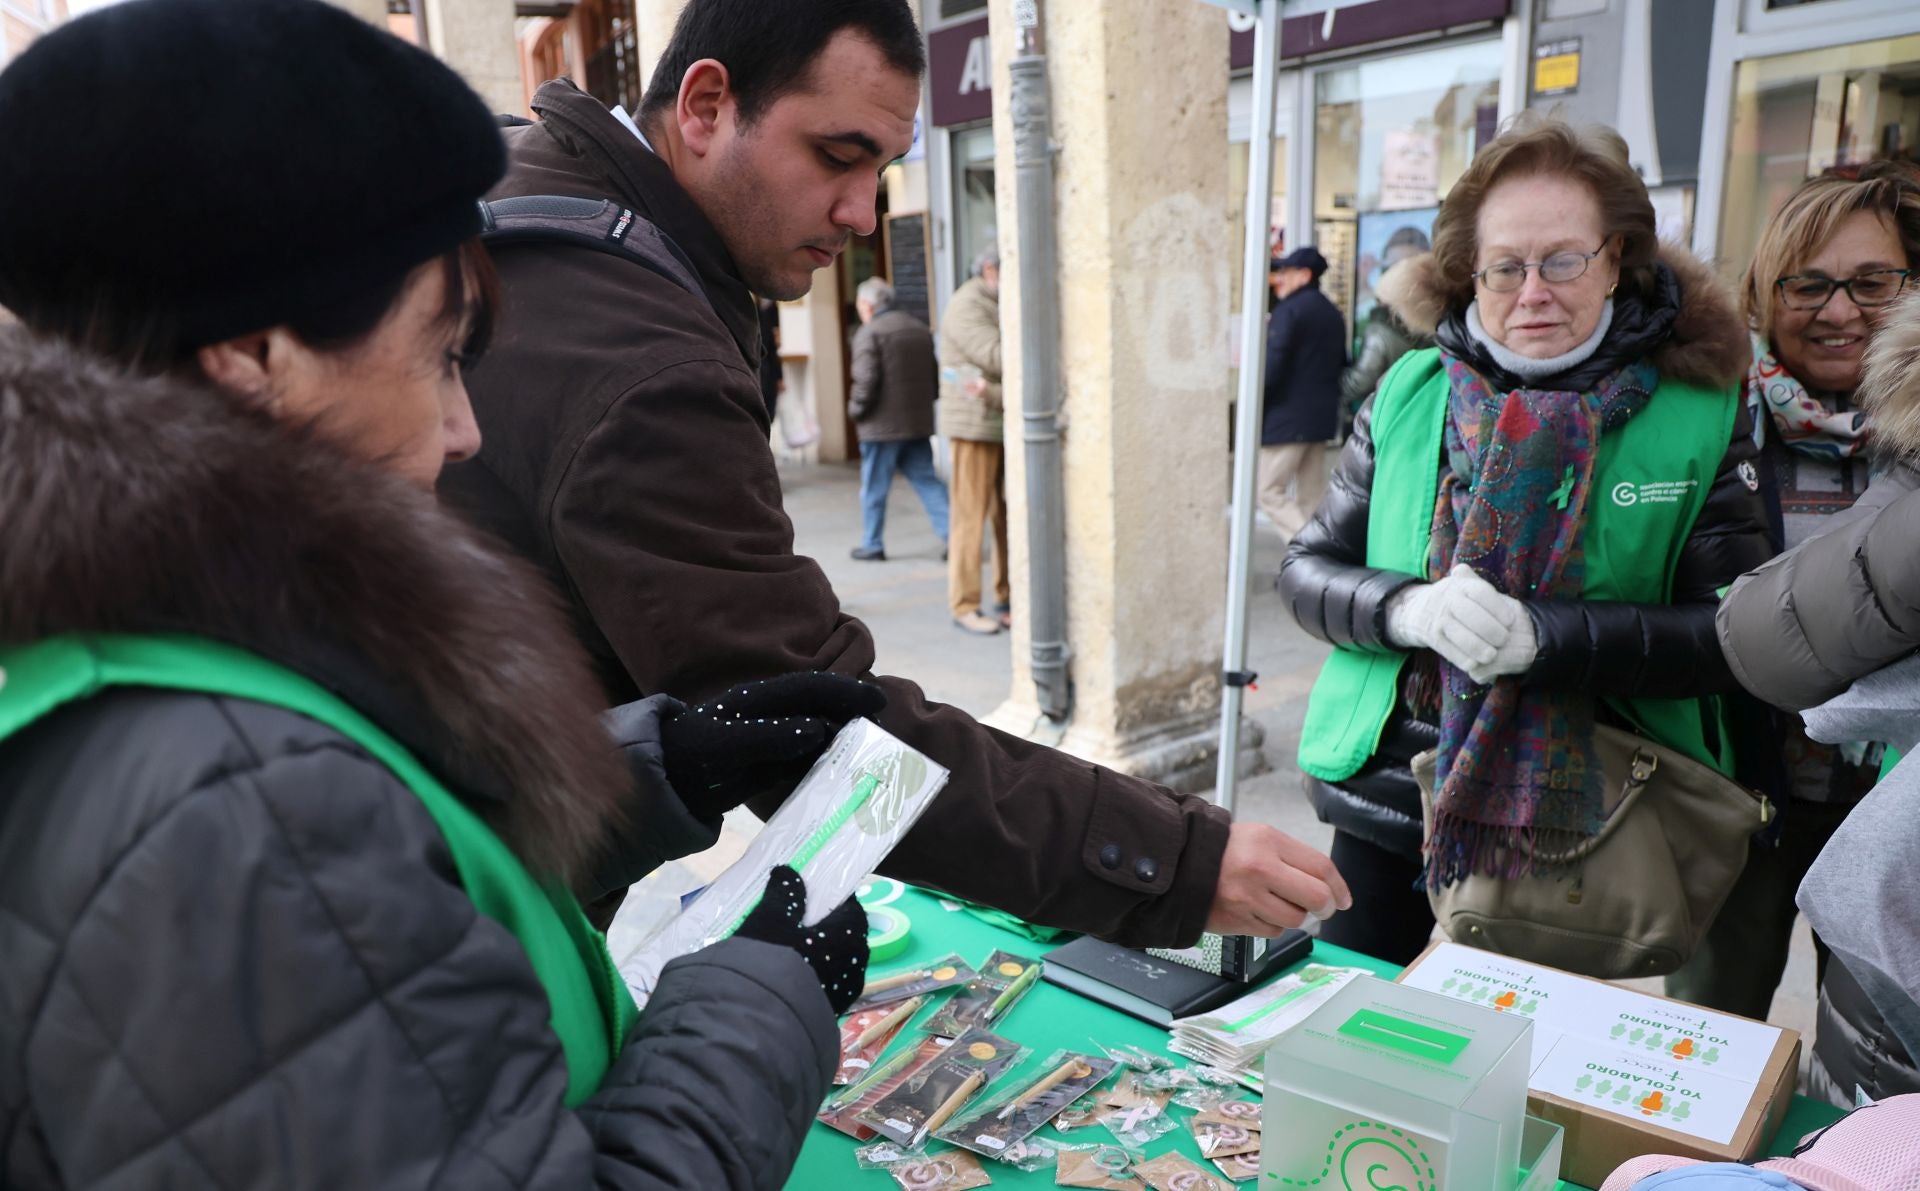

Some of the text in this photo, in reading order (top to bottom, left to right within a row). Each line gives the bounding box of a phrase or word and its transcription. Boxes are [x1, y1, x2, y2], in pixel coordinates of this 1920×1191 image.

[1651, 495, 1678, 503] Palencia
[1453, 968, 1549, 999] YO COLABORO
[1619, 1013, 1729, 1046] YO COLABORO
[1586, 1062, 1702, 1100] YO COLABORO
